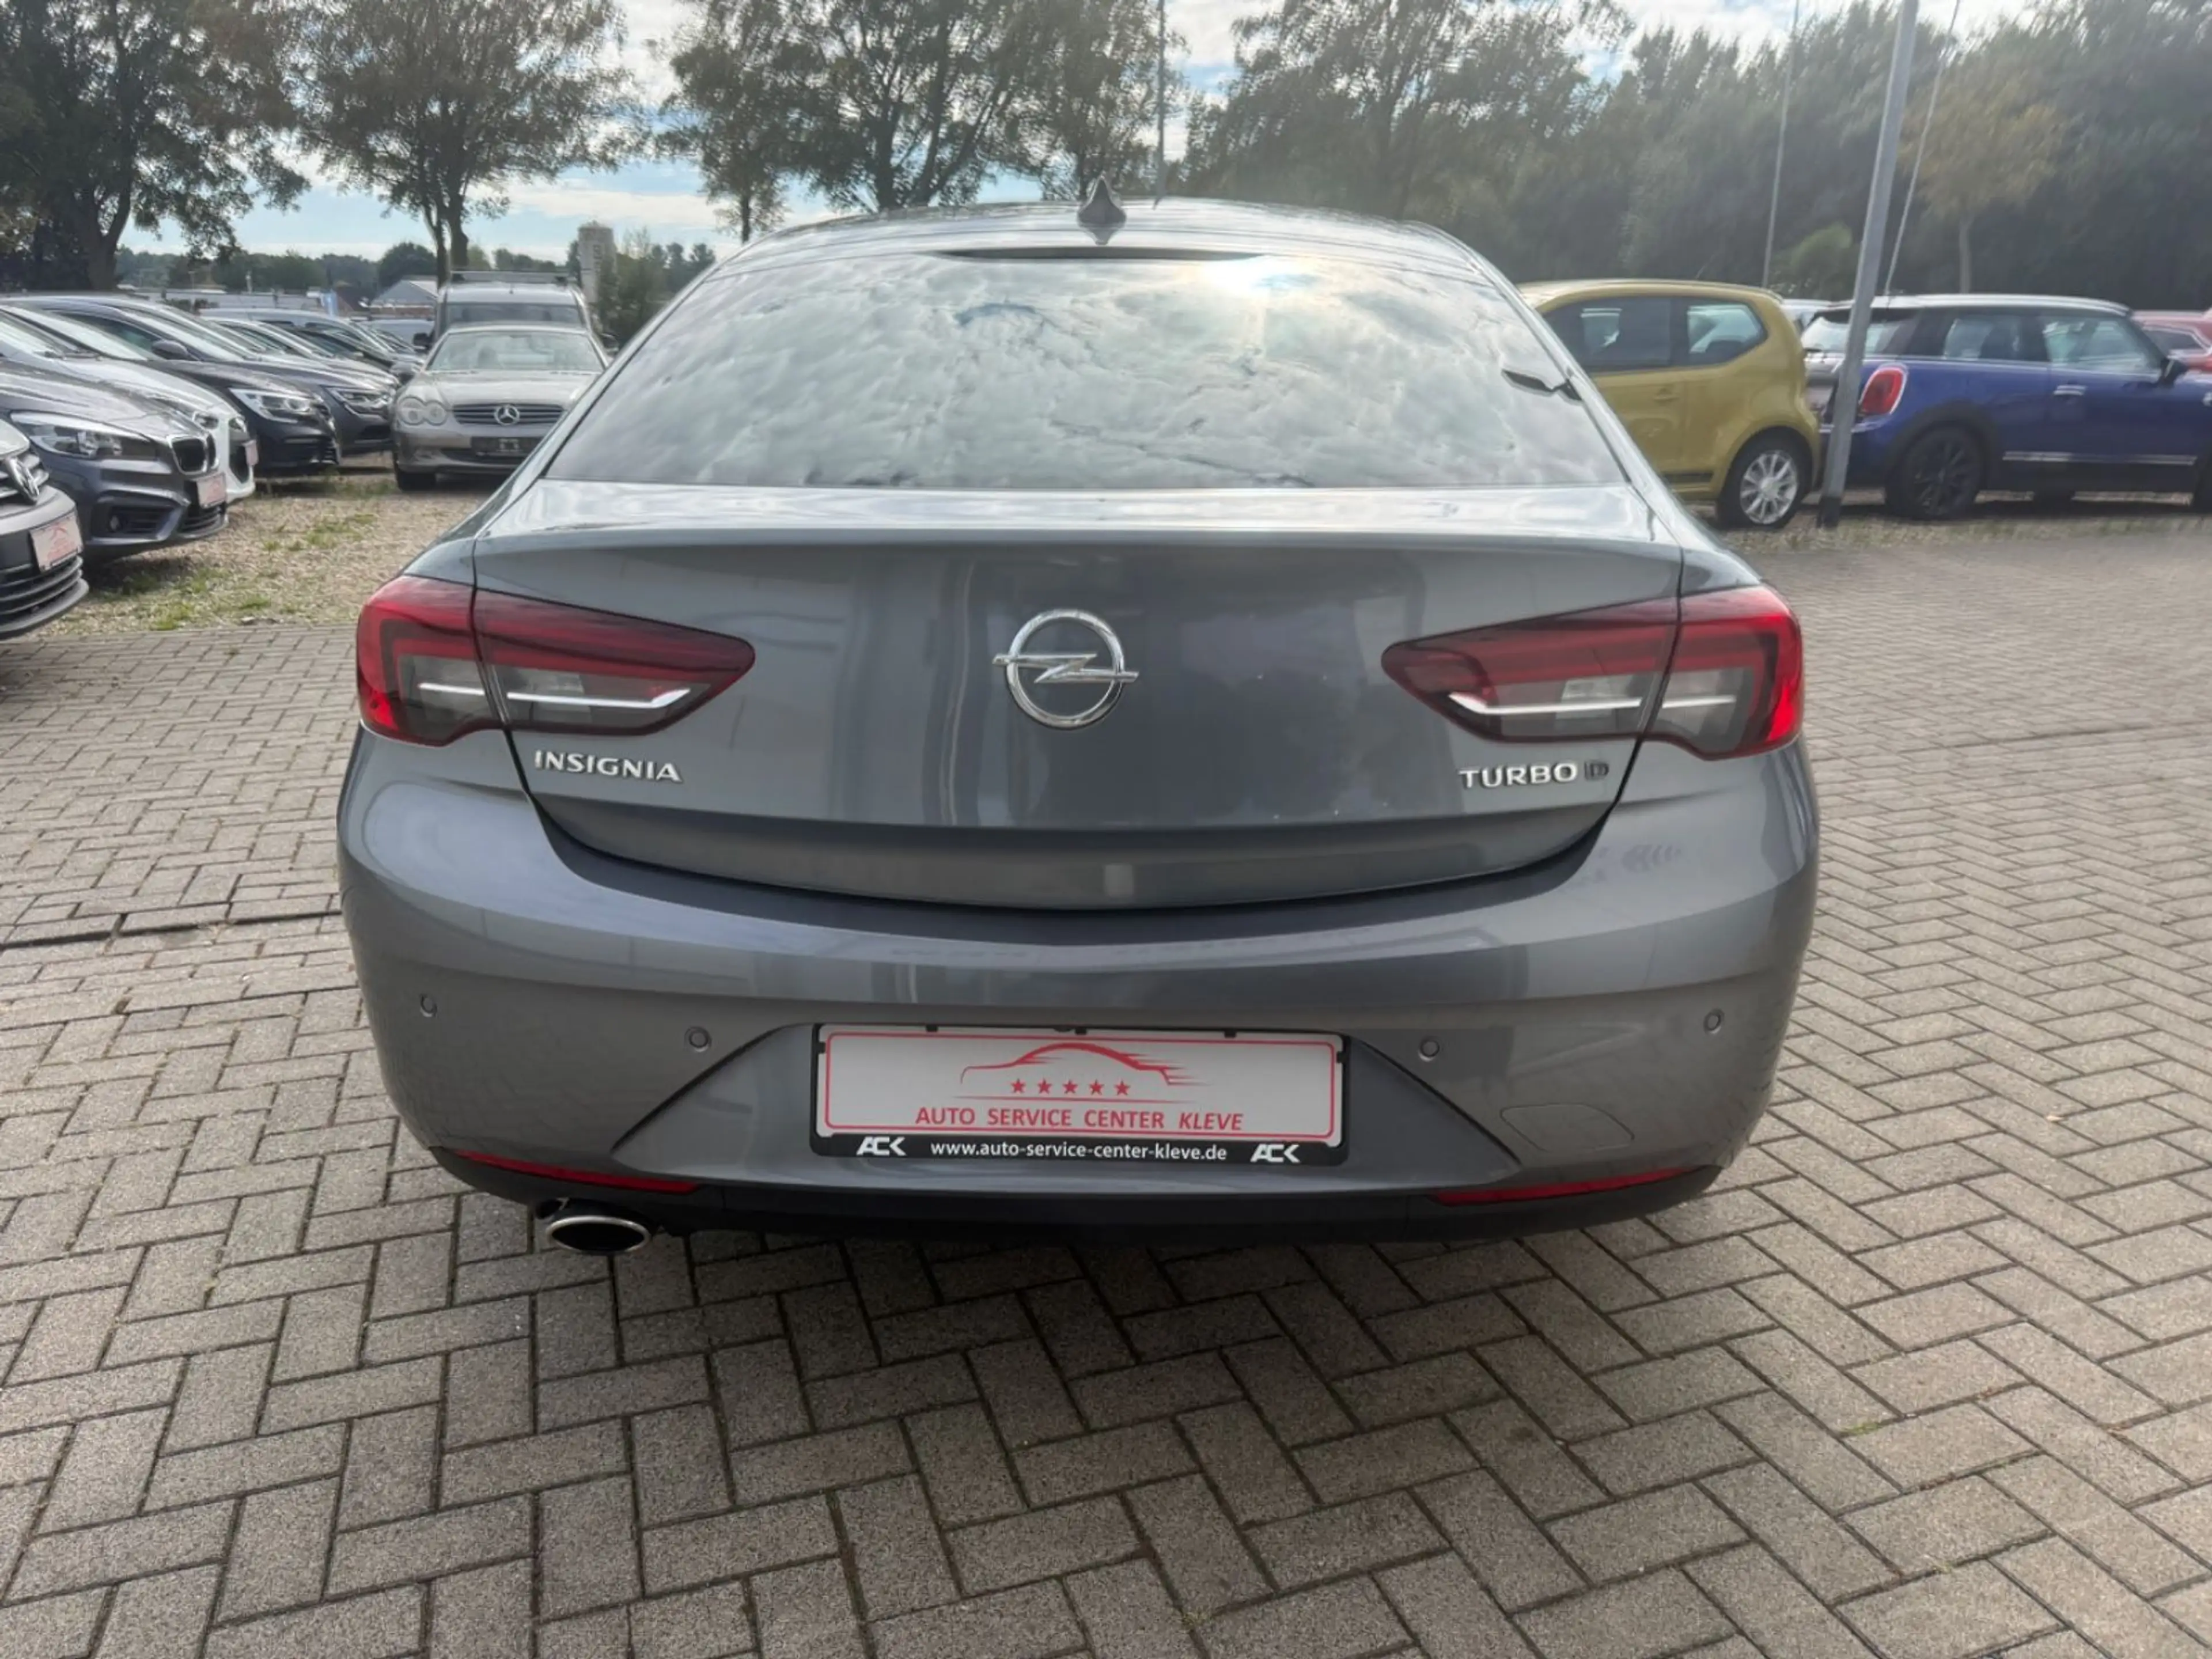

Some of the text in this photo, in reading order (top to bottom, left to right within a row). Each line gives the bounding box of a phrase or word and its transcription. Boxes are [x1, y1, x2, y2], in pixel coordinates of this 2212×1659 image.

[534, 749, 683, 783] INSIGNIA
[1459, 762, 1578, 789] TURBO
[915, 1107, 1244, 1131] AUTO SERVICE CENTER KLEVE
[930, 1140, 1228, 1160] www.auto-service-center-kleve.de
